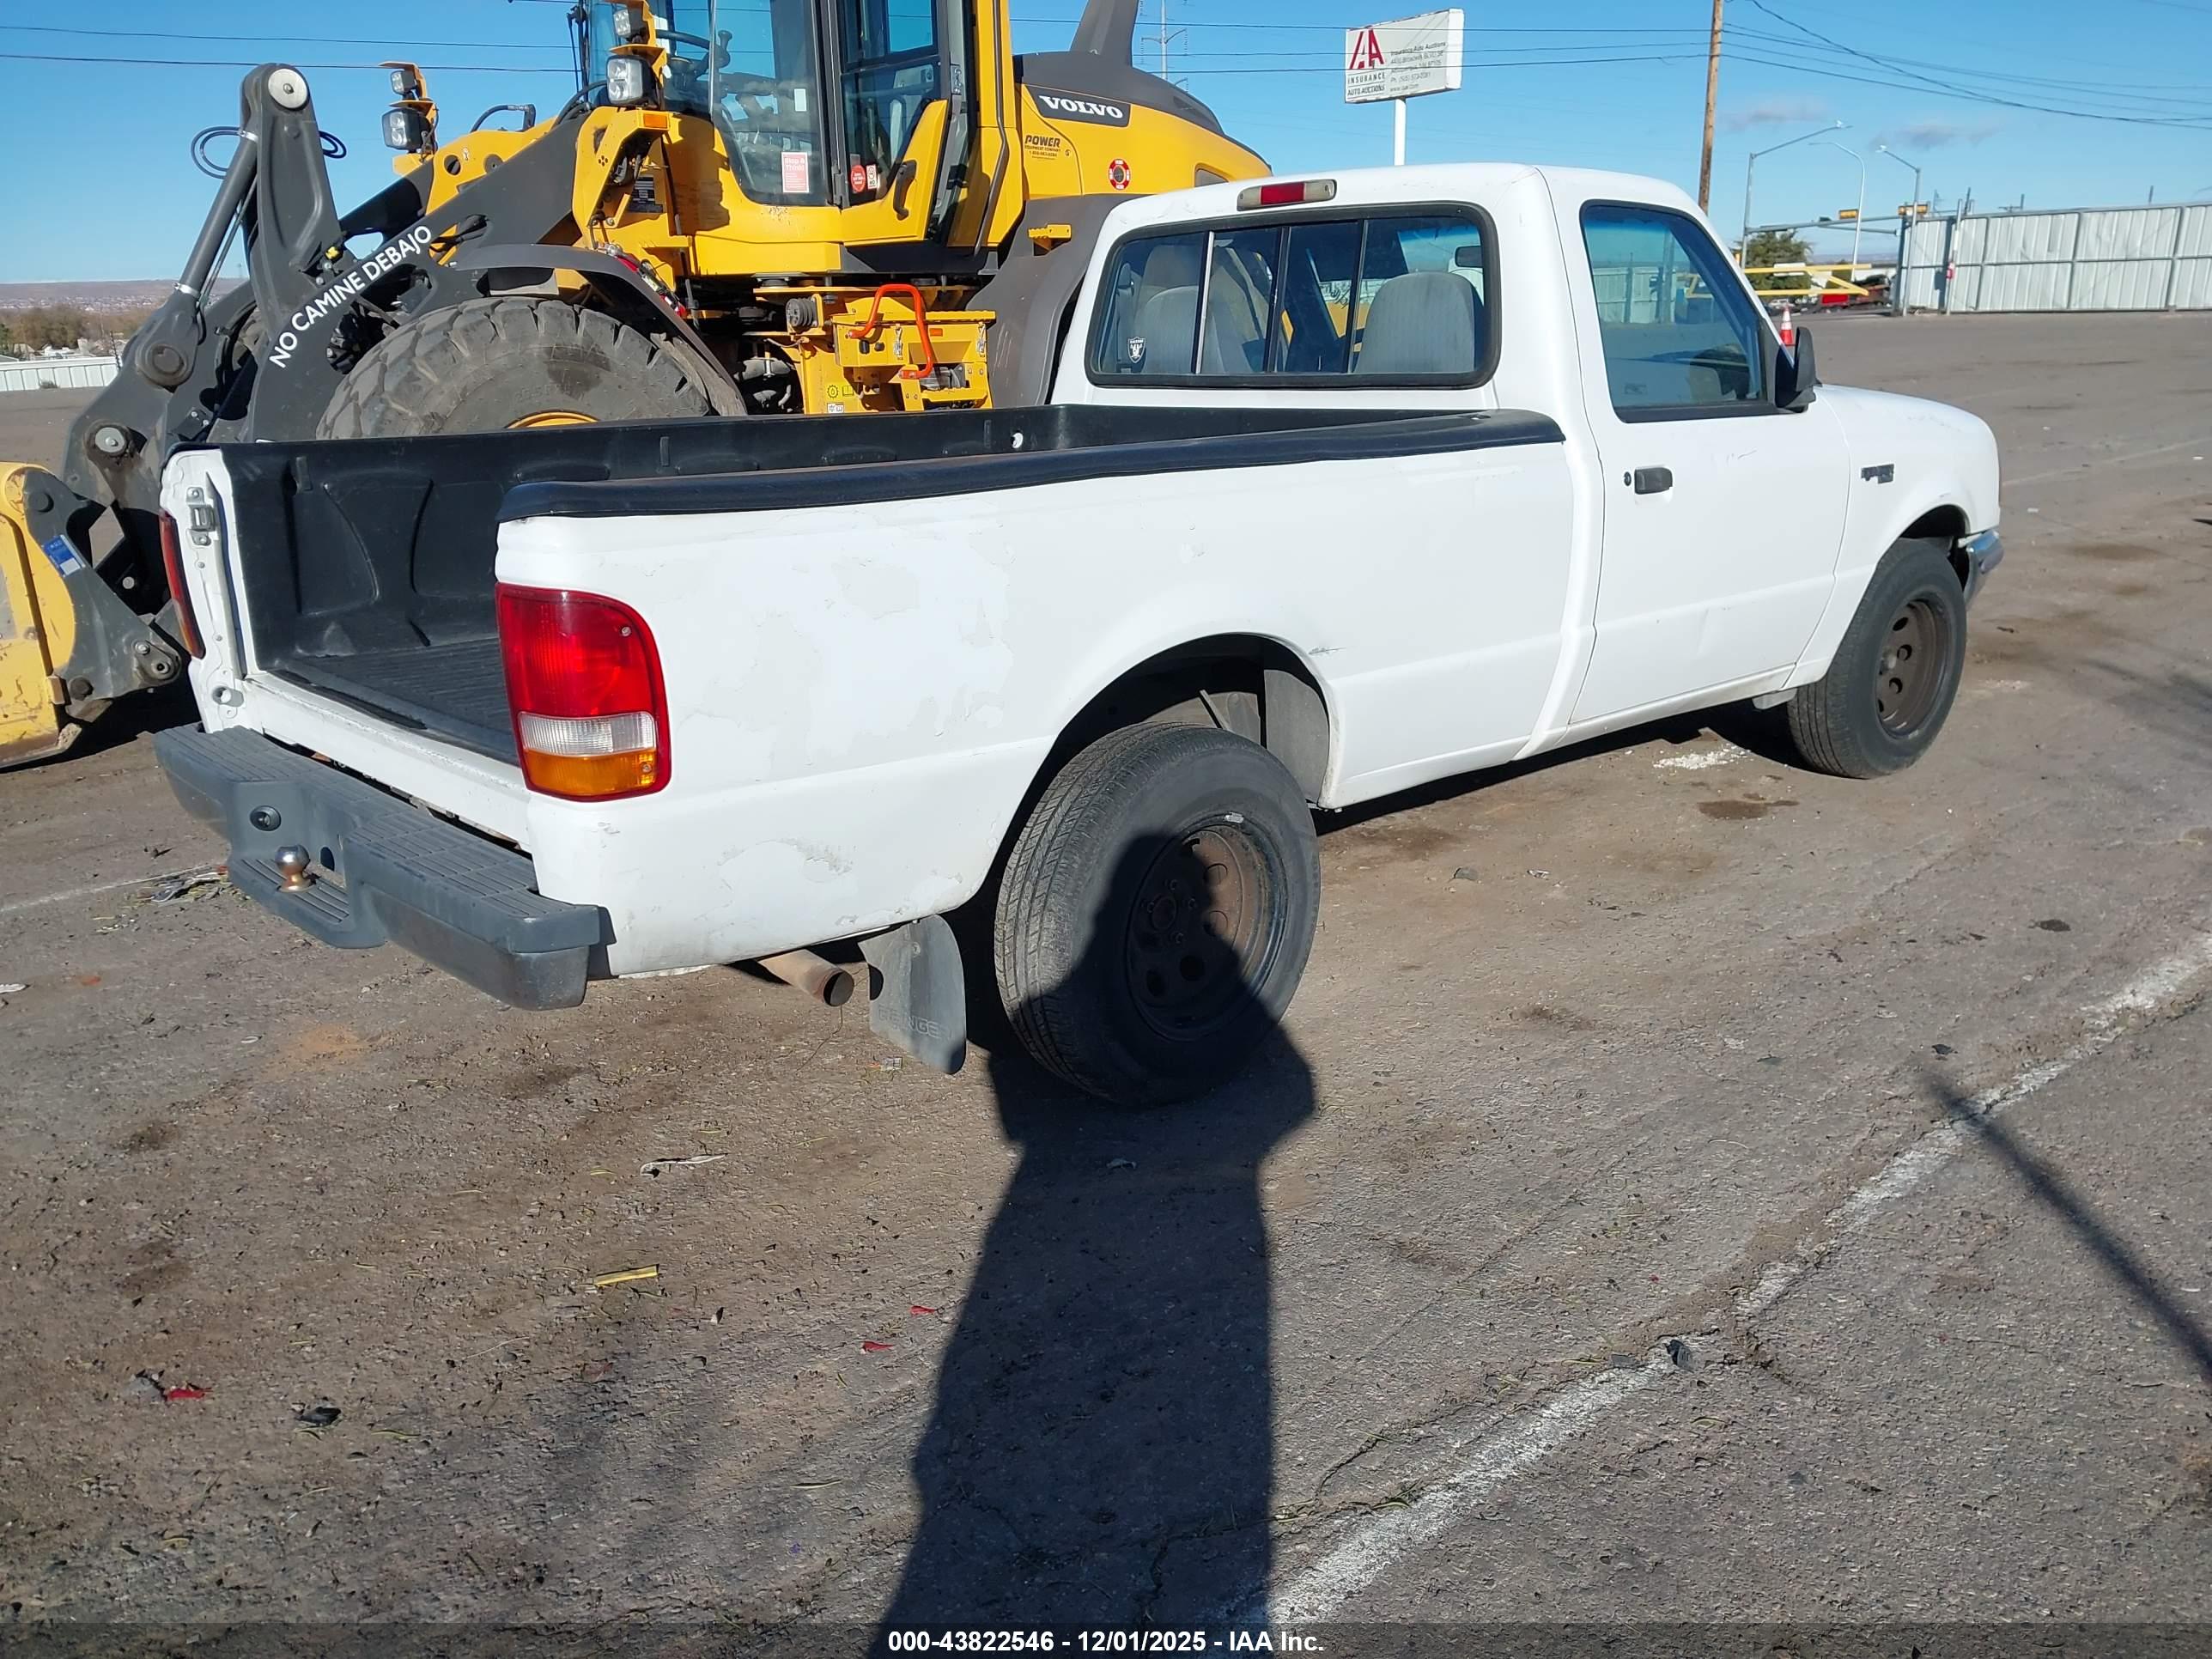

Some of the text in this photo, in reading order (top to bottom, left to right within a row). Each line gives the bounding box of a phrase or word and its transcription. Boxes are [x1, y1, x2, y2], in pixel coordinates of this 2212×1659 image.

[1347, 72, 1385, 84] INSURANCE
[1347, 87, 1360, 96] AUTO
[1361, 84, 1385, 94] AUCTIONS
[1038, 95, 1123, 119] VOLVO
[1024, 134, 1060, 148] POWER
[269, 225, 431, 368] NO CAMINE DEBAJO
